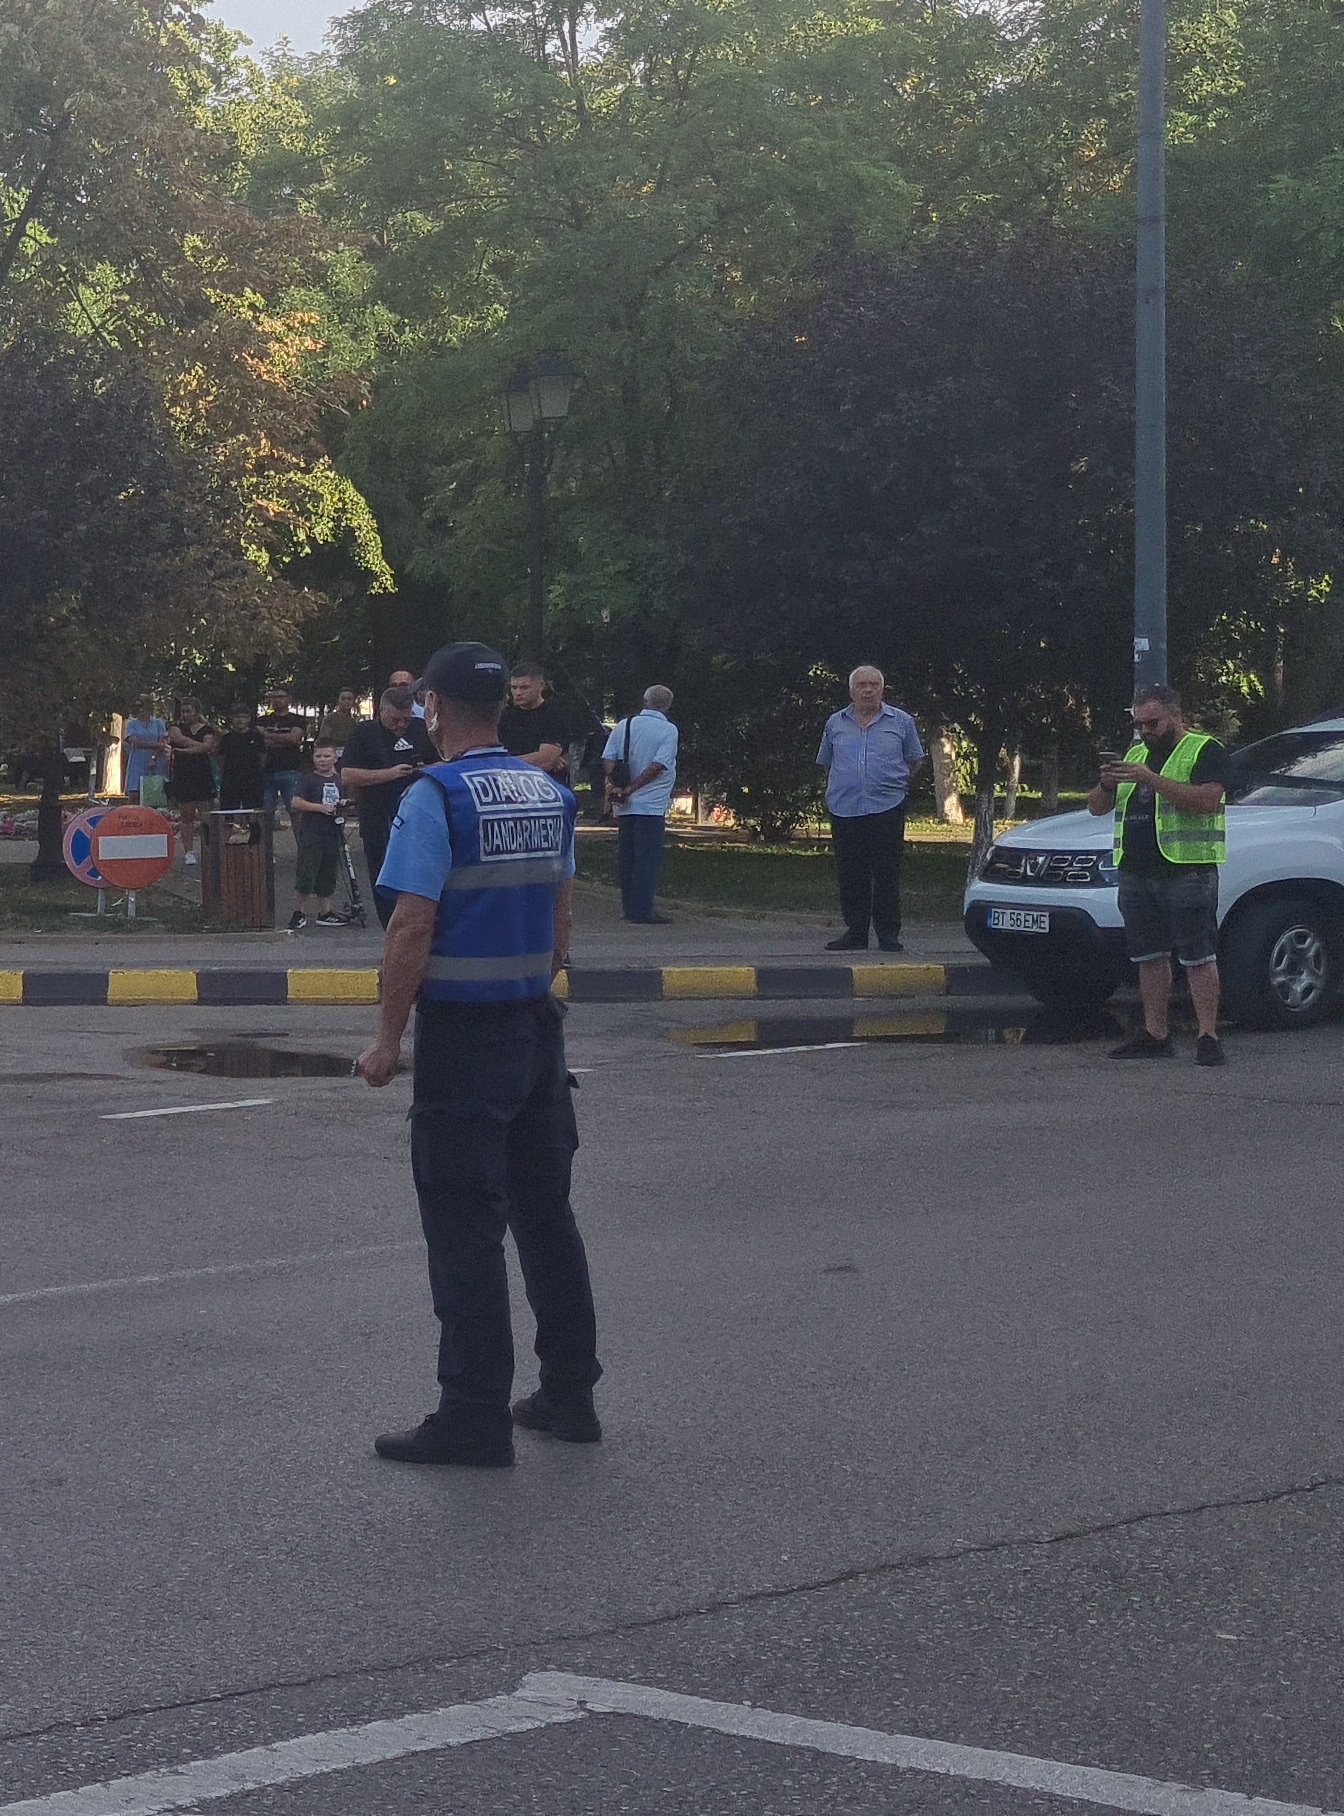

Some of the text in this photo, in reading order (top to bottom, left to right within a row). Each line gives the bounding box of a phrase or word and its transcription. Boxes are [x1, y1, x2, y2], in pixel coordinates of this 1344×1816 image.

[472, 774, 557, 803] DIALOG
[992, 910, 1007, 927] BT
[1009, 912, 1022, 928] 56
